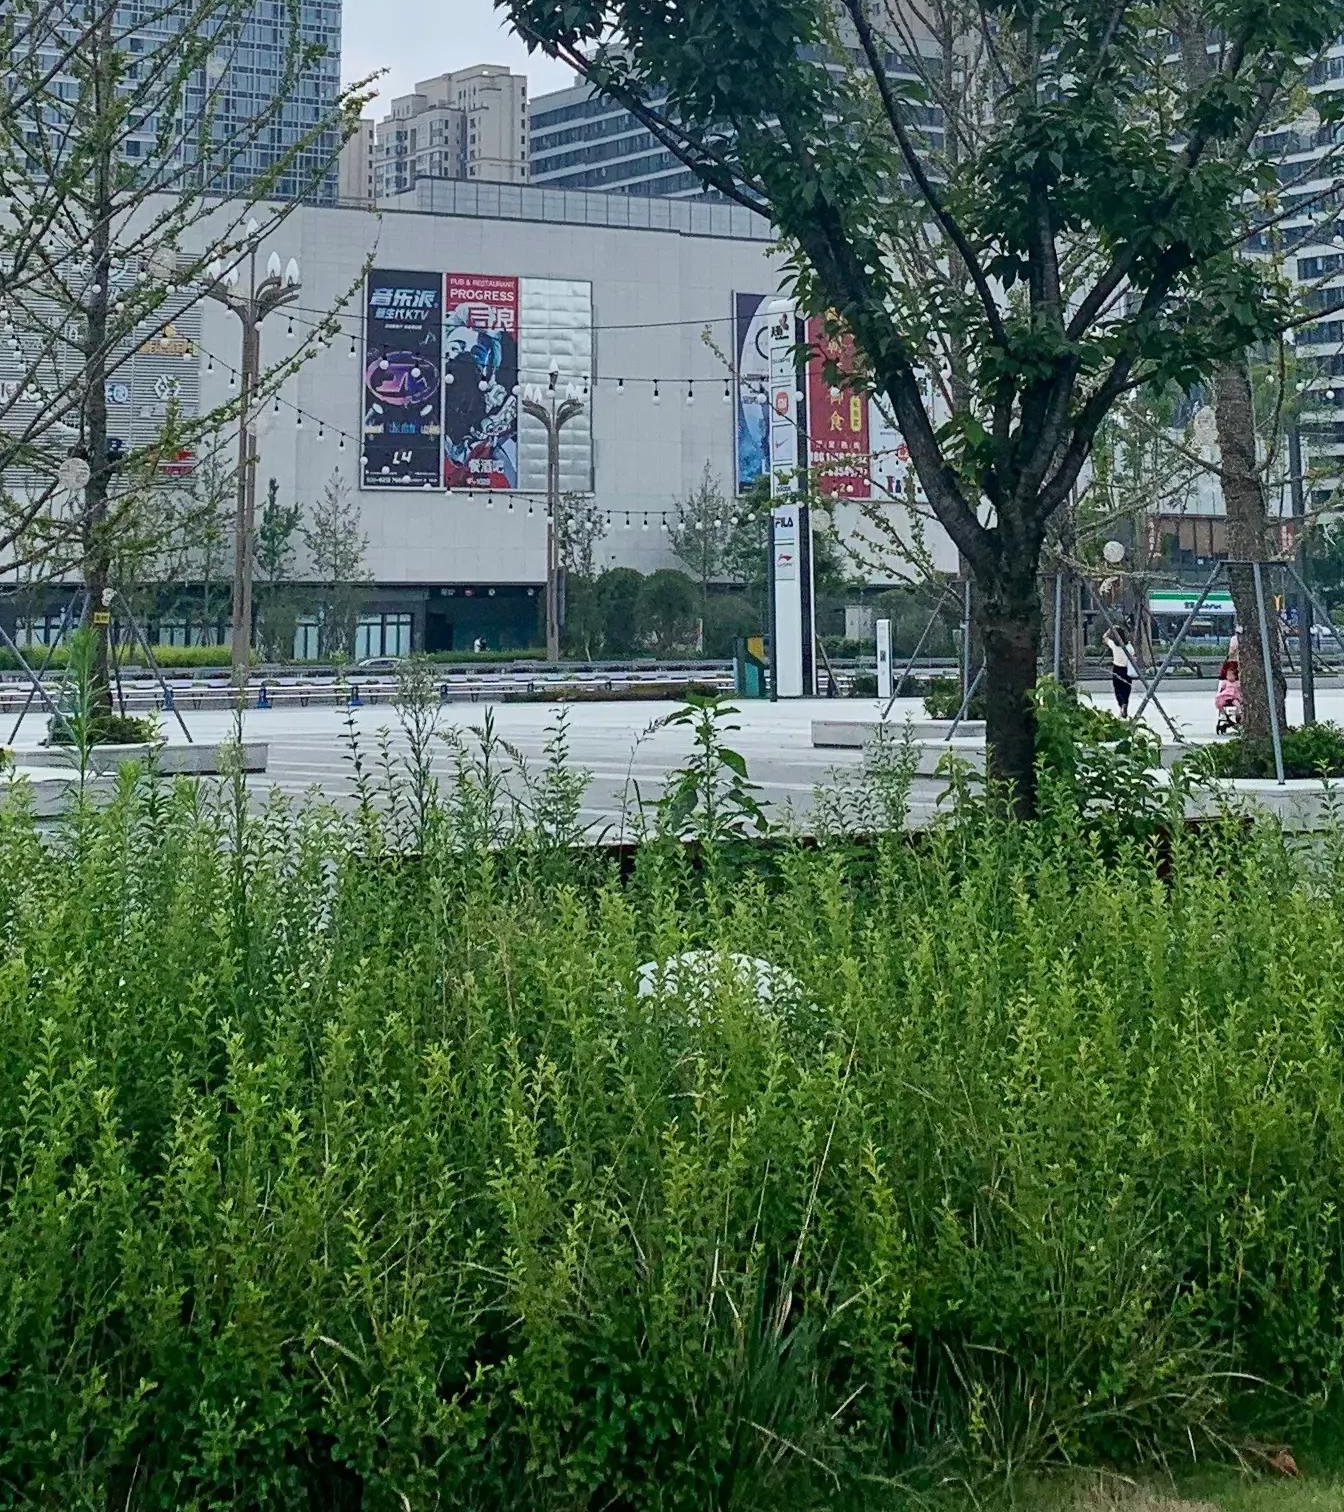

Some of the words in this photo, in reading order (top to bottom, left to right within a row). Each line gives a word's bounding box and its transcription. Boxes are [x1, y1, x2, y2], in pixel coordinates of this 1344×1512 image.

[369, 287, 437, 308] 音乐派
[450, 288, 515, 302] PROGRESS
[774, 517, 794, 529] FILA
